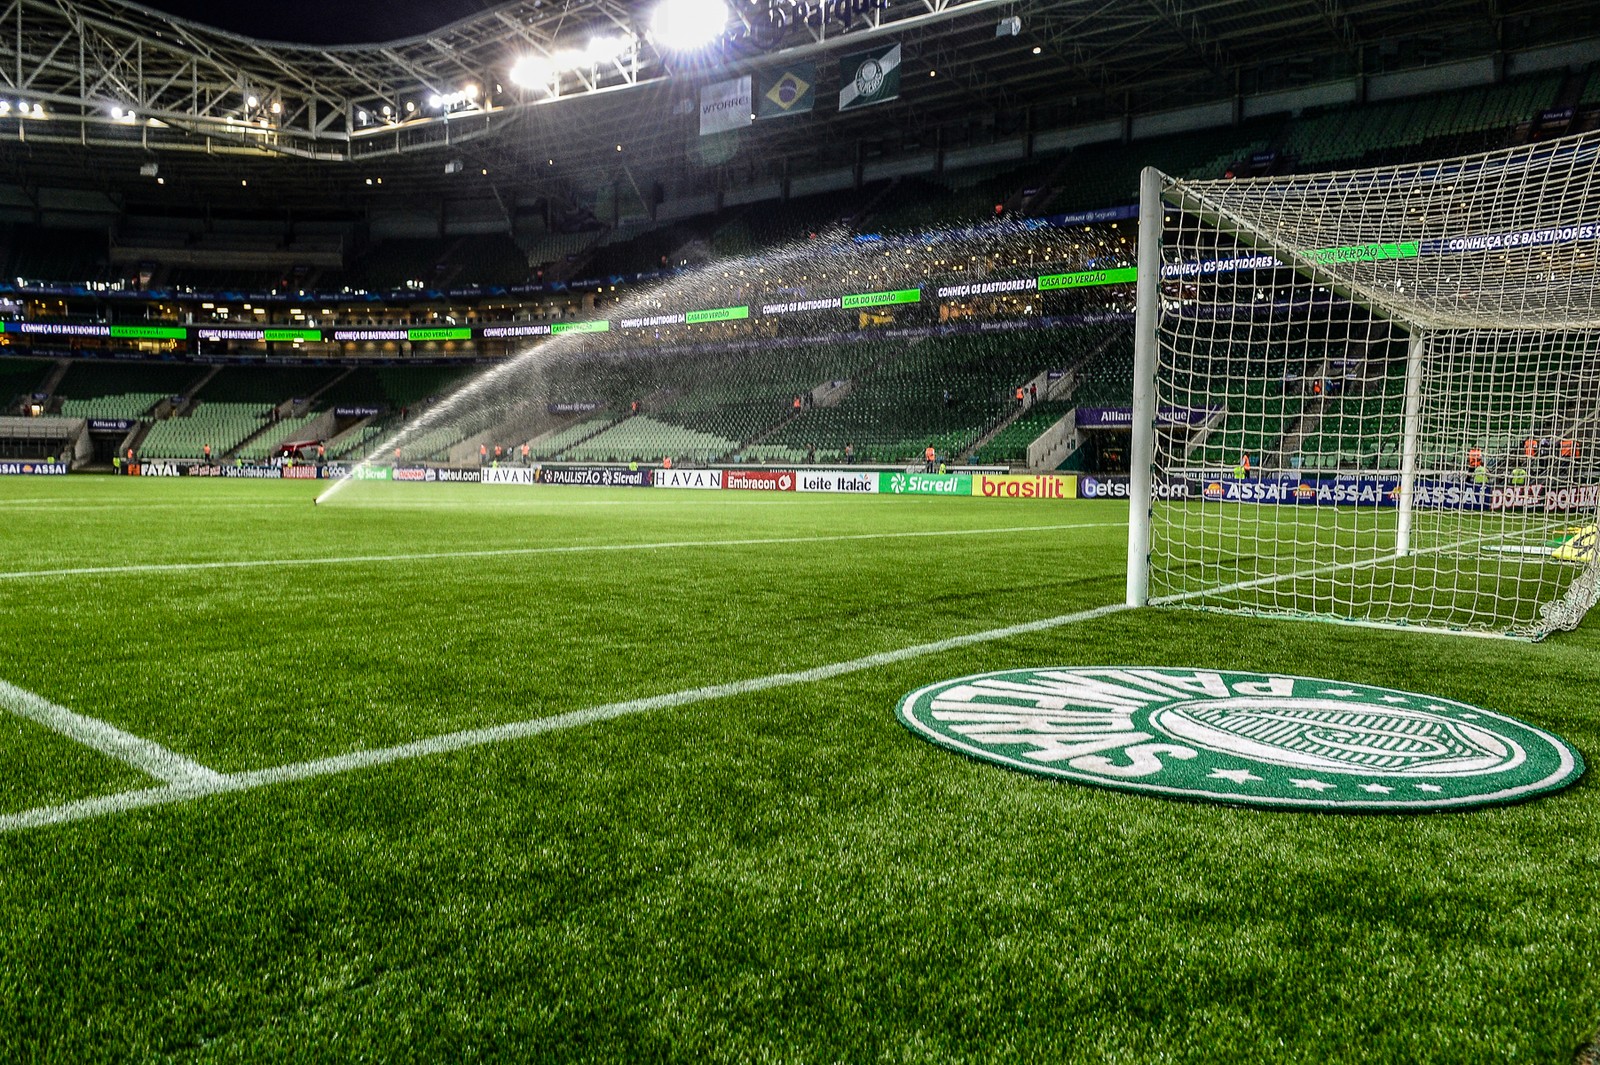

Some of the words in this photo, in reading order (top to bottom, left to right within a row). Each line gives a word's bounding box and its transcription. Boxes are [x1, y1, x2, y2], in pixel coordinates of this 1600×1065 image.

[1204, 261, 1216, 272] OS
[938, 285, 970, 297] CONHEÇA
[971, 284, 981, 294] OS
[982, 280, 1025, 293] BASTIDORES
[1025, 279, 1037, 289] DA
[1040, 277, 1060, 287] CASA
[1061, 276, 1073, 285] DO
[1074, 273, 1106, 284] VERDÃO
[861, 296, 870, 304] DO
[871, 293, 896, 303] VERDÃO
[21, 323, 52, 334] CONHEÇA
[52, 324, 61, 334] OS
[100, 325, 110, 336] DA
[1101, 411, 1132, 422] Allian
[1158, 411, 1187, 422] arque
[141, 464, 180, 477] FATAL
[481, 469, 532, 482] HAVAN
[553, 469, 600, 484] PAULISTÃO
[613, 471, 643, 485] Sicredi
[656, 472, 721, 486] HAVAN
[727, 475, 776, 490] Embracon
[804, 477, 832, 490] Leite
[837, 476, 872, 491] Italac
[908, 477, 958, 492] Sicredi
[982, 475, 1064, 498] brasilit
[930, 668, 1292, 777] PALMEIRAS
